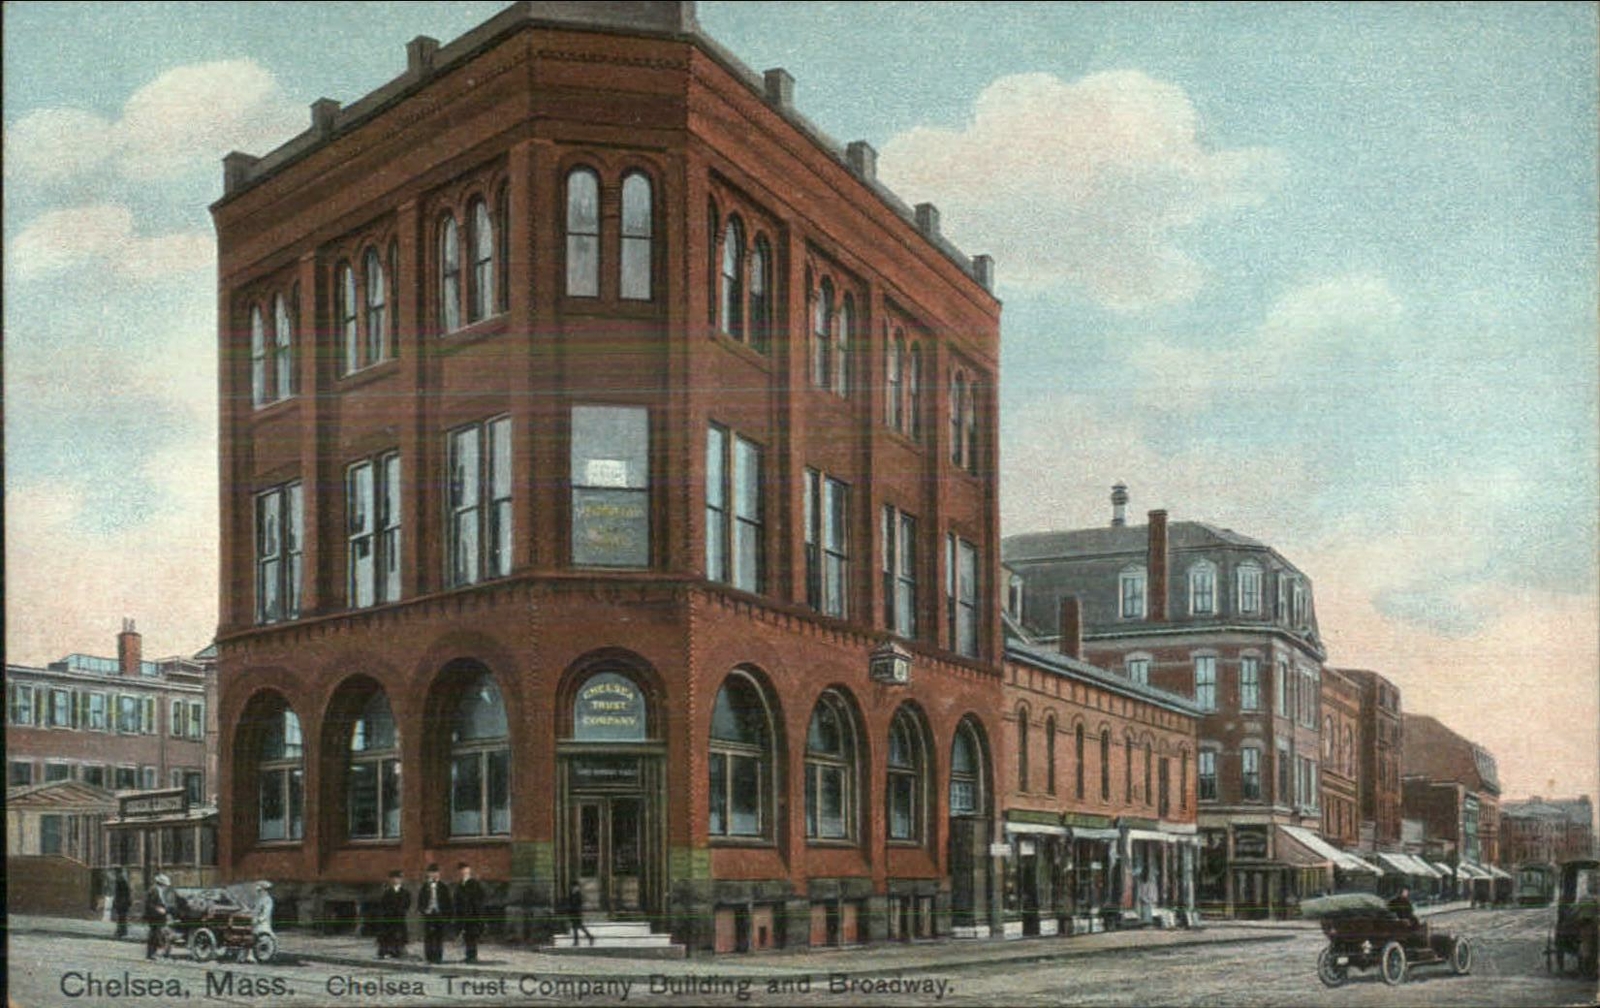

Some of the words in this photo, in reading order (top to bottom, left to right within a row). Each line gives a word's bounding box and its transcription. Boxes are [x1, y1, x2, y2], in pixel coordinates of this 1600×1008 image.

[583, 683, 634, 700] CHELSEA
[591, 700, 628, 711] TRUST
[582, 715, 637, 726] COMPANY
